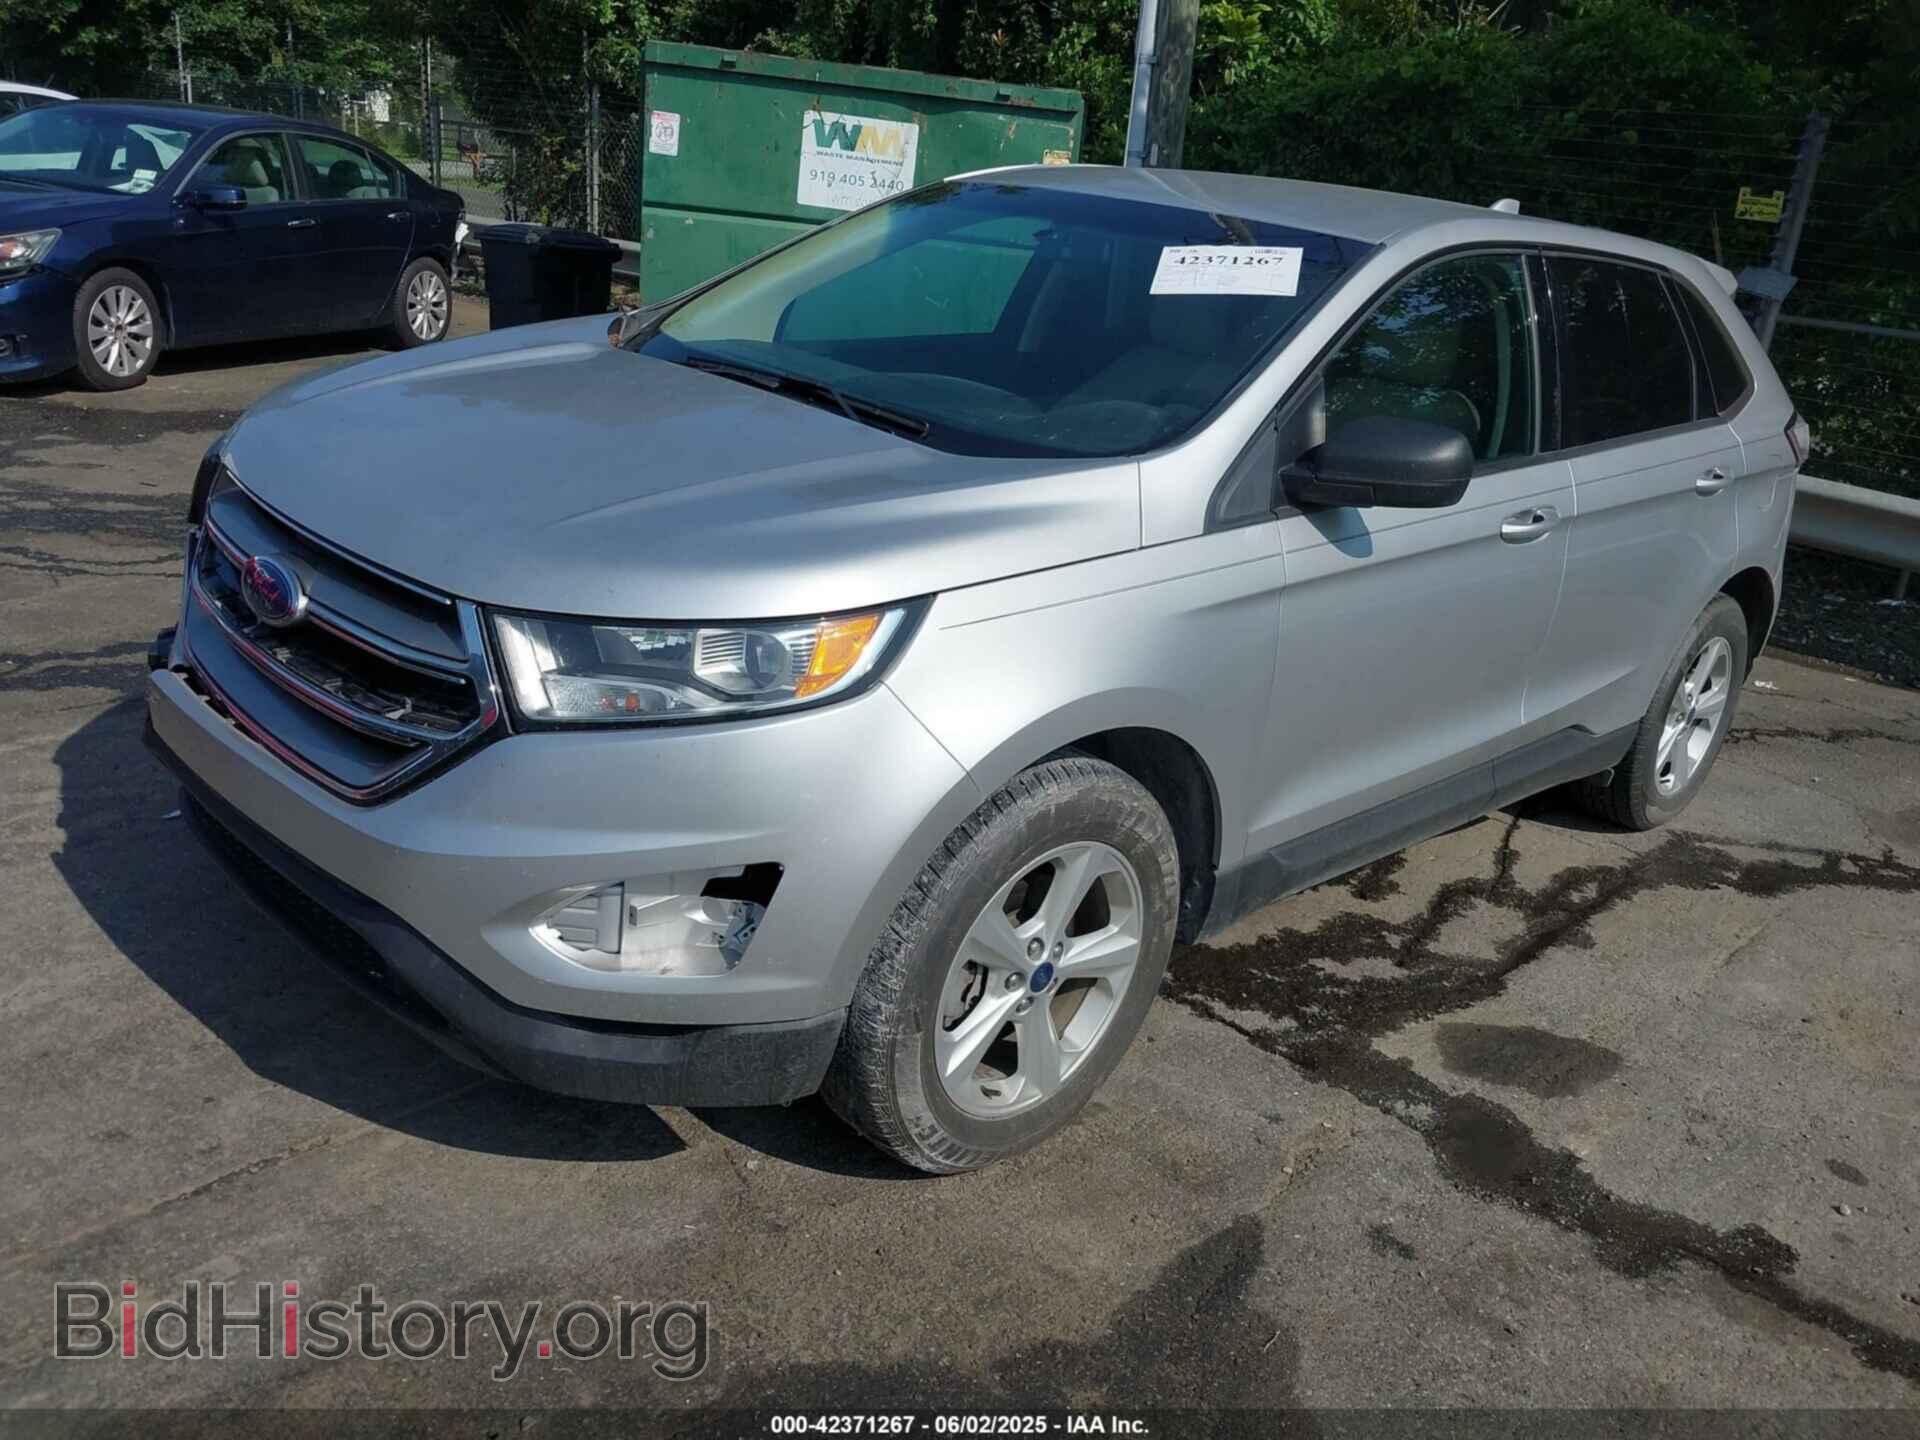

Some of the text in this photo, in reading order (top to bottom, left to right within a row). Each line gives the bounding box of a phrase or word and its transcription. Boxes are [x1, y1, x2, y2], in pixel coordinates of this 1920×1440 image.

[812, 118, 905, 160] WM
[809, 168, 836, 182] 919
[839, 173, 865, 187] 405
[1173, 255, 1284, 266] 42371267
